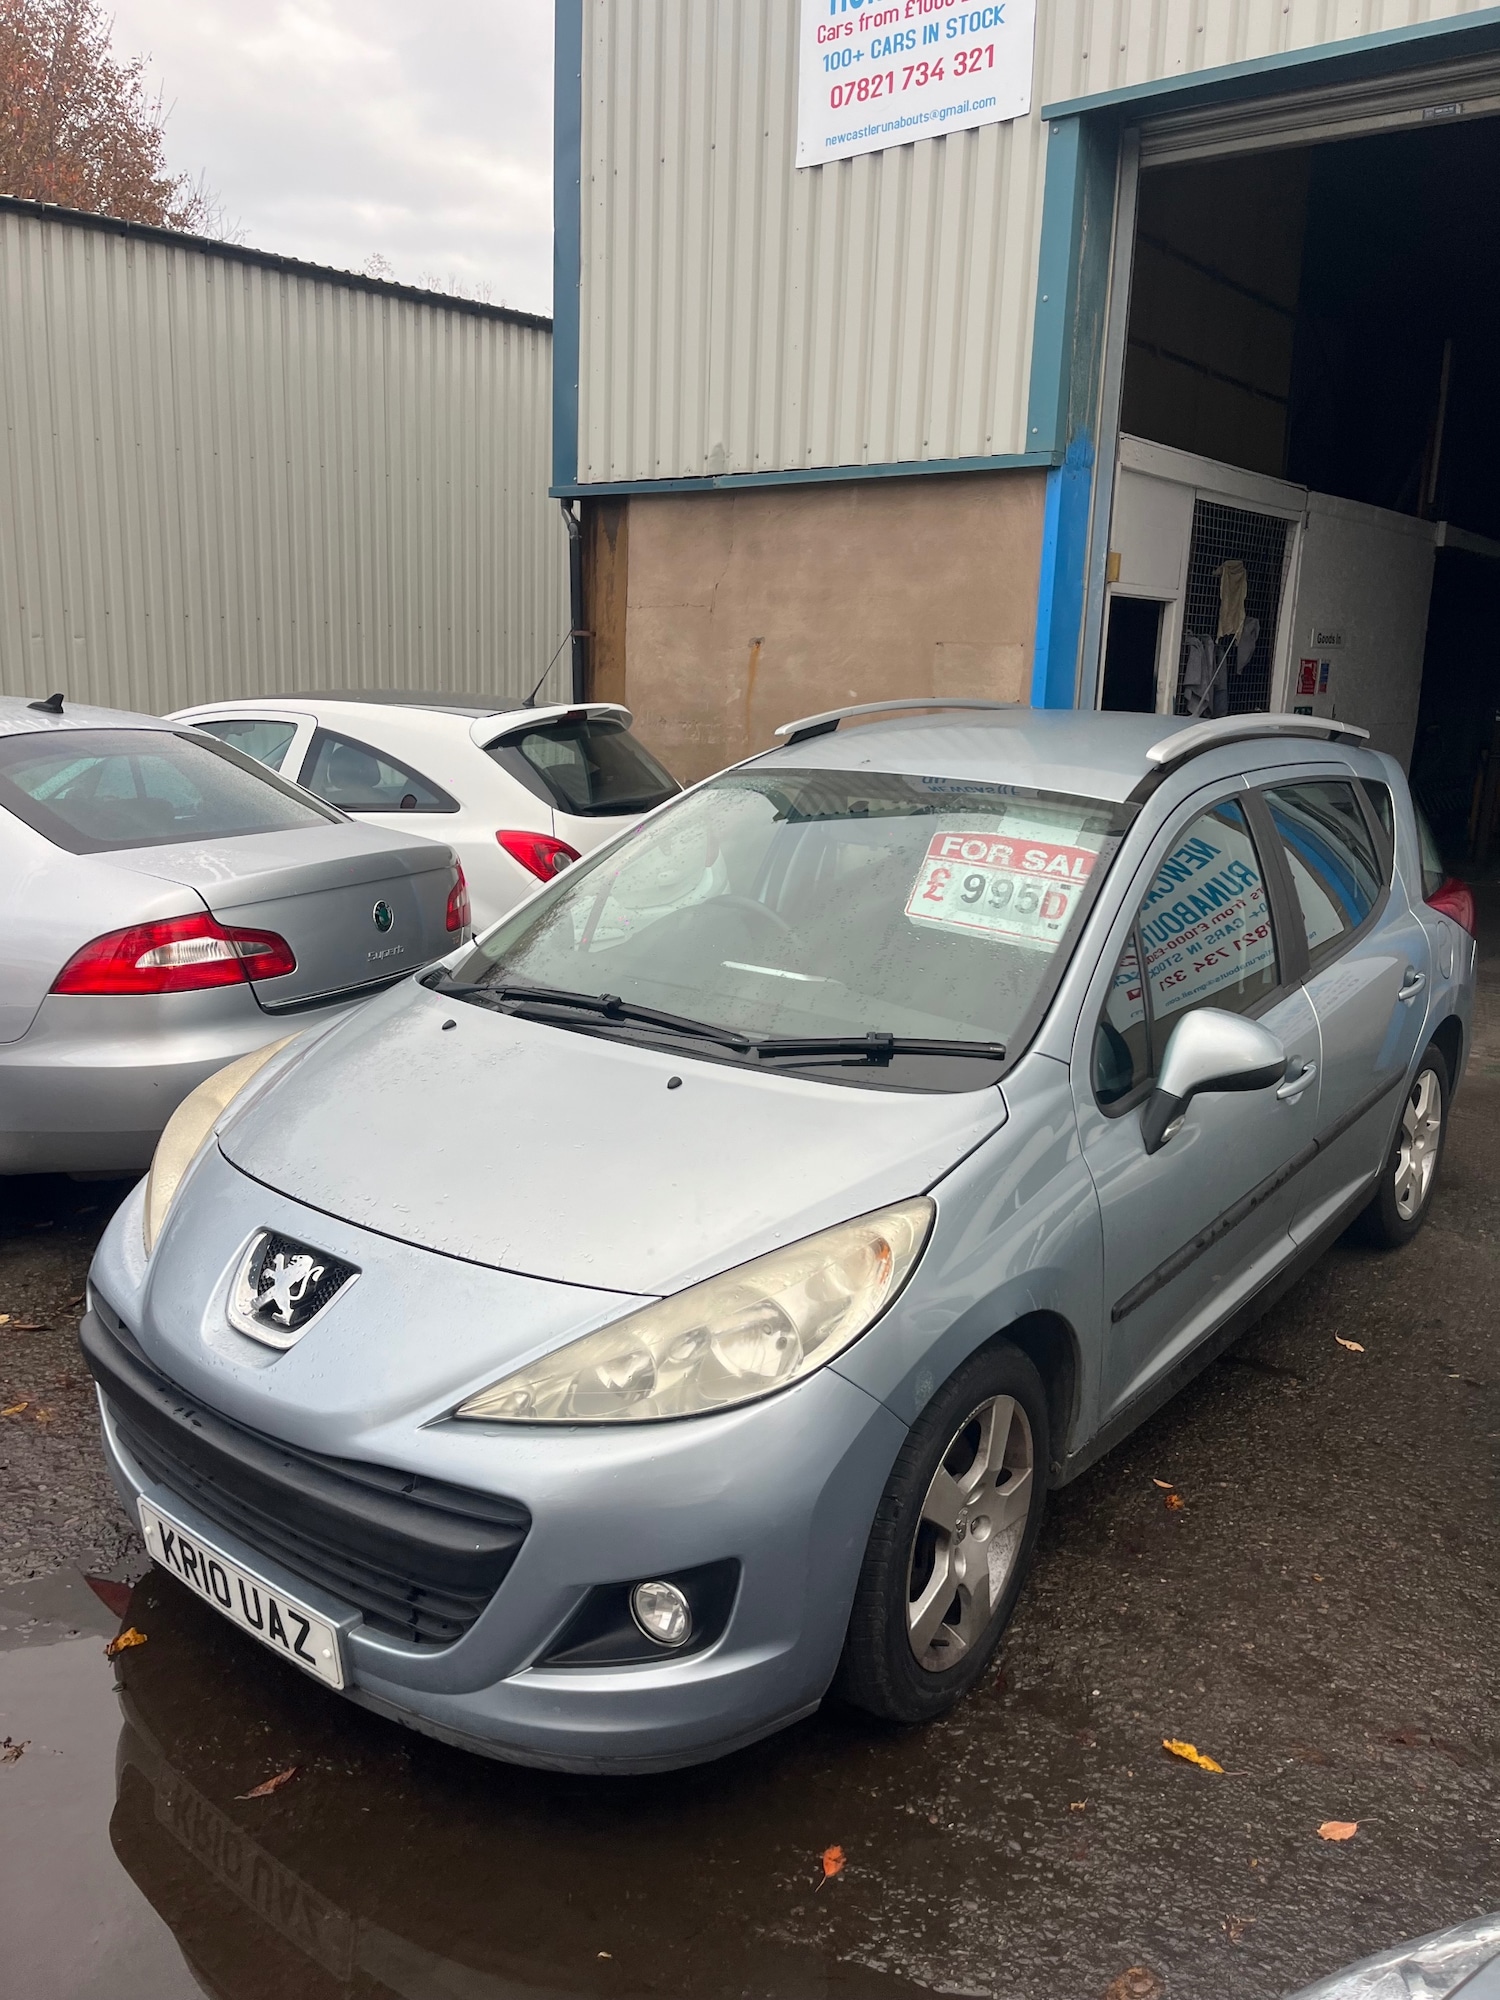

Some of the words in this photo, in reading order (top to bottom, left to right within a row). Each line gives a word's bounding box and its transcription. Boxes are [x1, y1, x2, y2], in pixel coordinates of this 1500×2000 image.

[817, 21, 853, 44] Cars
[859, 8, 899, 32] from
[822, 48, 865, 72] 100+
[870, 29, 917, 60] CARS
[923, 23, 939, 45] IN
[945, 4, 1006, 39] STOCK
[829, 70, 895, 109] 07821
[901, 57, 945, 91] 734
[953, 44, 995, 77] 321
[825, 96, 997, 147] newcastlerunabouts@gmail.com
[1317, 632, 1335, 645] Goods
[940, 836, 1014, 866] FOR
[1021, 849, 1091, 880] SAL
[157, 1520, 232, 1609] KR10
[237, 1577, 317, 1666] UAZ
